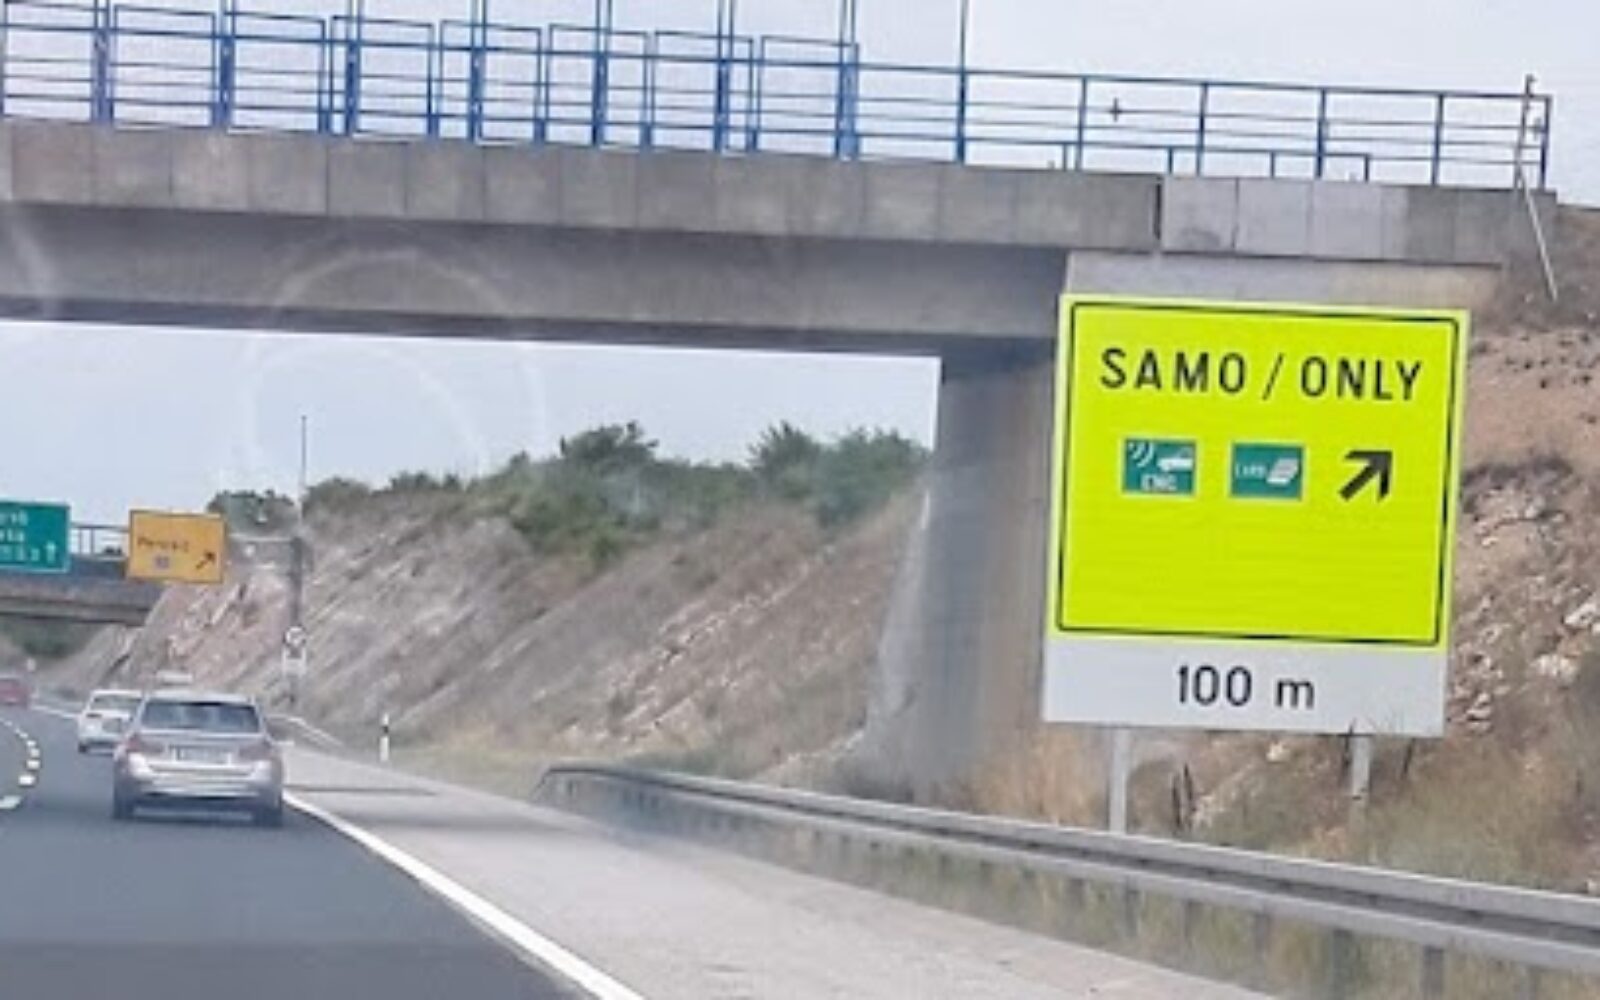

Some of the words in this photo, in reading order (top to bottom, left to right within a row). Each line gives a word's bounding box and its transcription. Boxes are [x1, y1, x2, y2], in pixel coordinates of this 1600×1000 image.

[1100, 347, 1246, 393] SAMO
[1261, 353, 1284, 401] /
[1300, 355, 1422, 401] ONLY
[1178, 665, 1253, 707] 100
[1276, 679, 1315, 709] m
